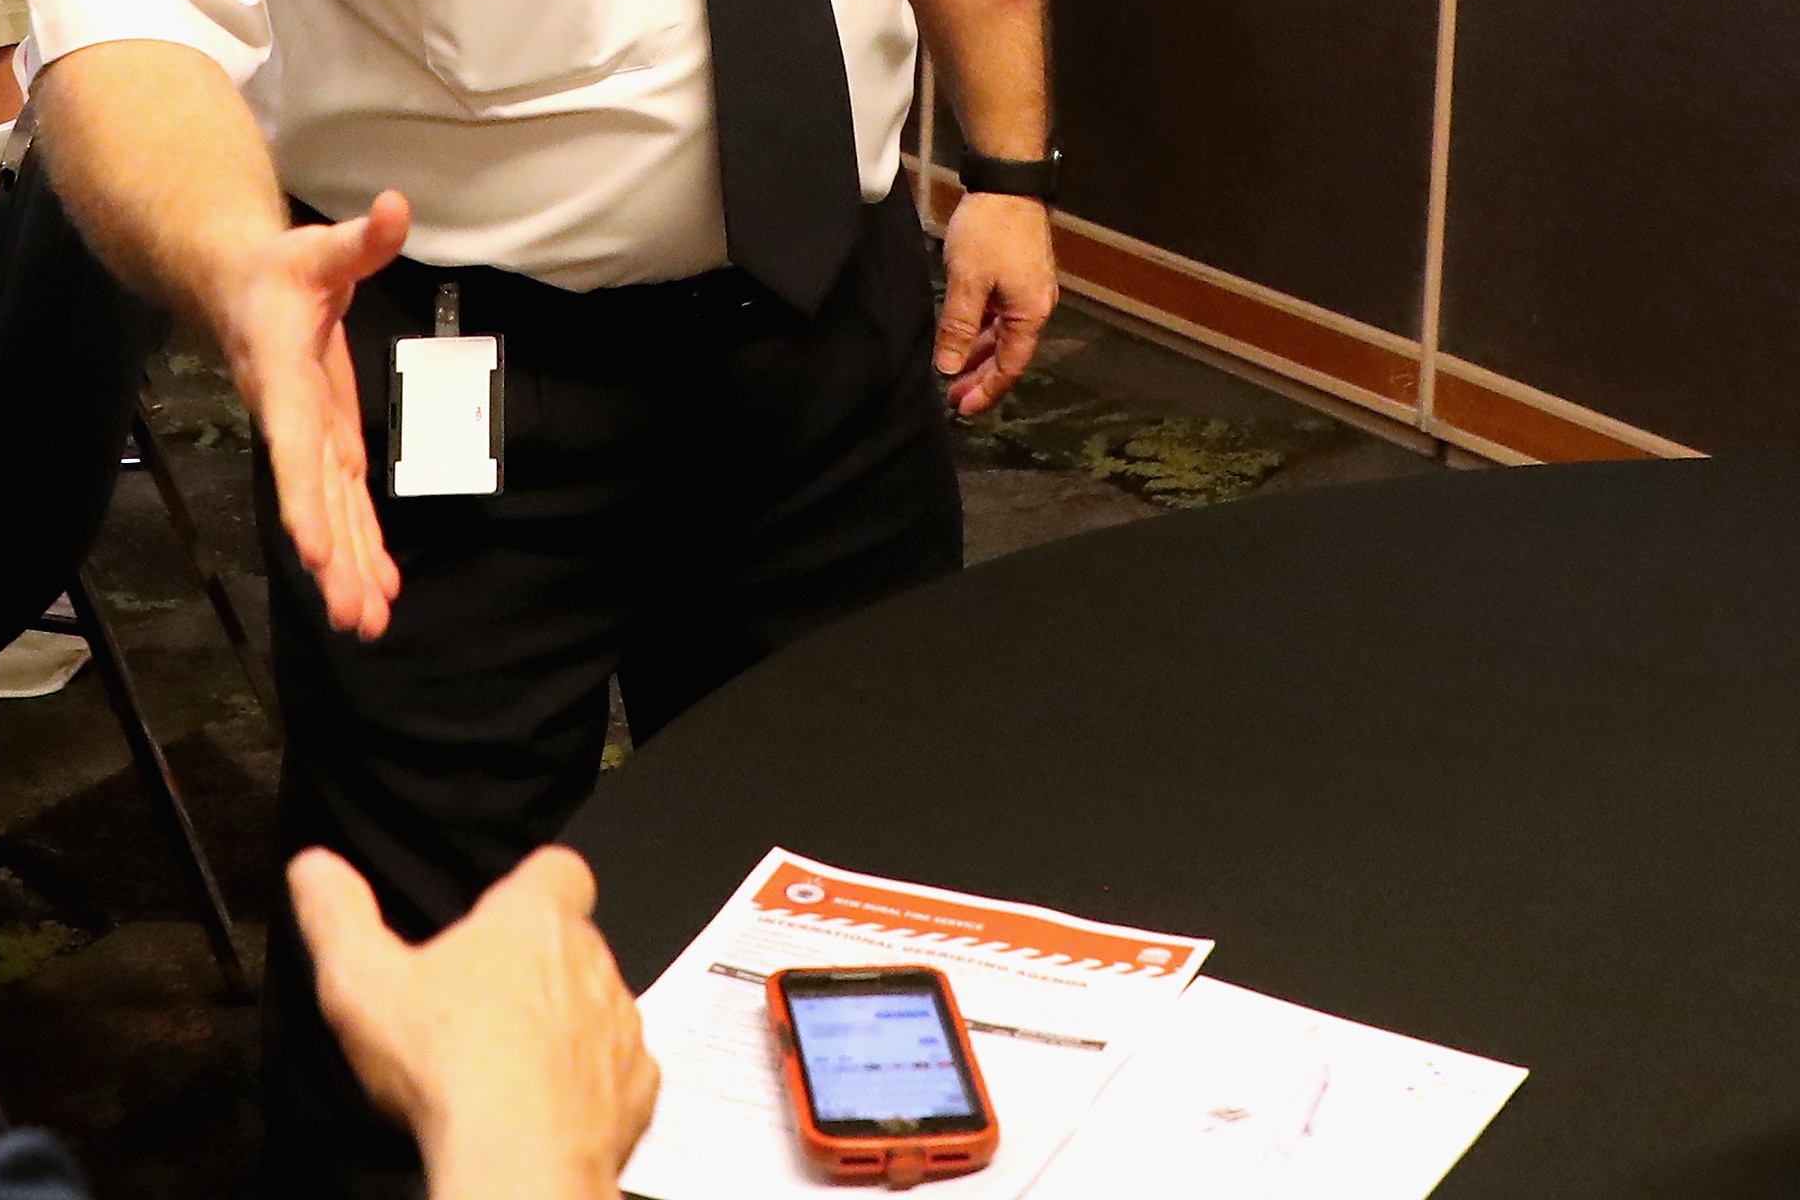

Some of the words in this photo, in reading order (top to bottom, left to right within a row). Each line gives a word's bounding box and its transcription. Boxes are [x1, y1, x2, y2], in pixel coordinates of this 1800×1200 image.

[863, 902, 901, 917] RURAL
[904, 909, 931, 923] FIRE
[933, 915, 985, 931] SERVICE
[757, 916, 893, 949] INTERNATIONAL
[902, 945, 1009, 971] DEBRIEFING
[1016, 969, 1087, 988] AGENDA
